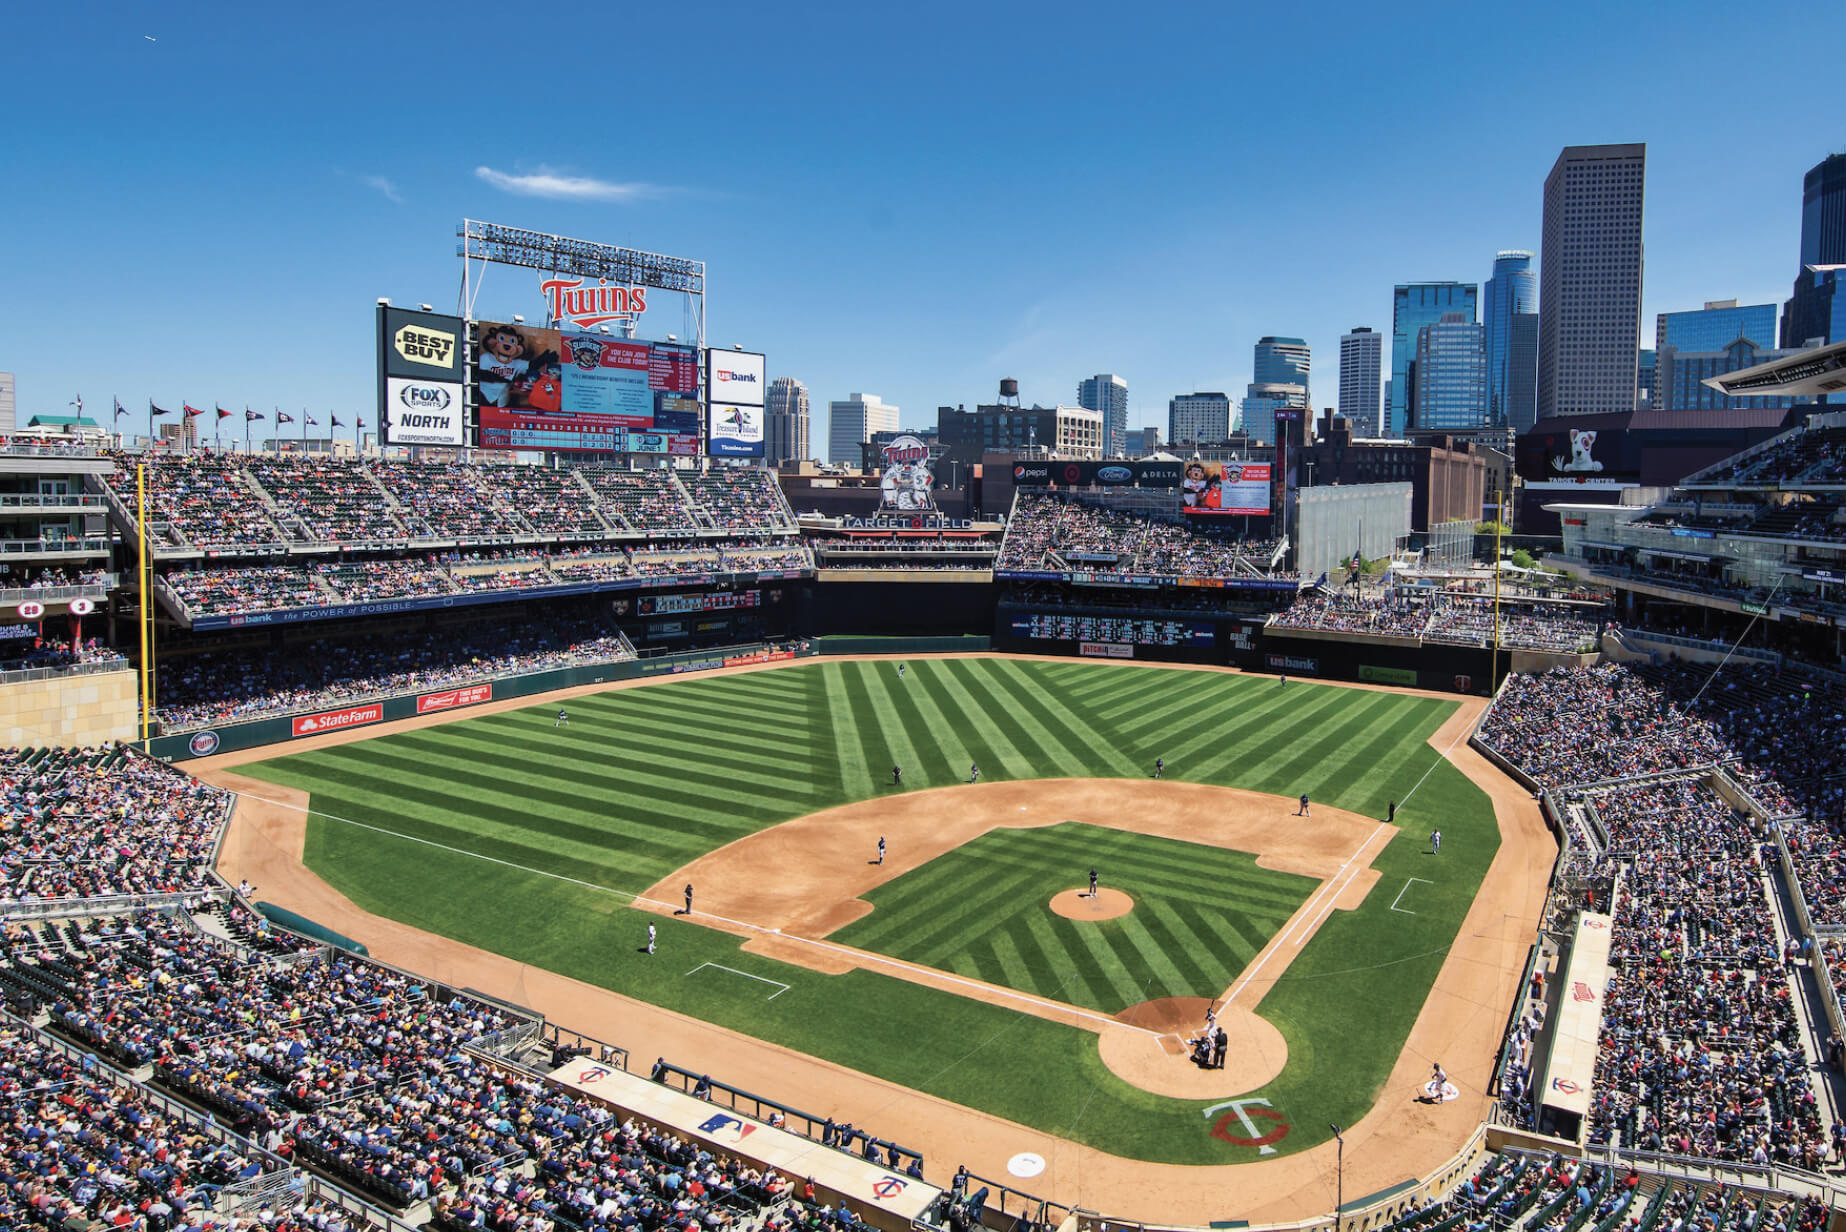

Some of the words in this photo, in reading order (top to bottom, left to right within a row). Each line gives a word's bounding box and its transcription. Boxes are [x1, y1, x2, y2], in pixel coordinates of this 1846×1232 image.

[541, 278, 647, 321] Twins
[403, 331, 453, 351] BEST
[404, 344, 448, 361] BUY
[411, 387, 440, 401] FOX
[401, 414, 450, 429] NORTH
[883, 446, 929, 465] Twins
[1025, 468, 1048, 478] pepsi
[845, 519, 907, 528] TARGET
[925, 519, 973, 529] FIELD
[79, 602, 86, 611] 3
[284, 613, 298, 621] the
[302, 608, 344, 619] POWER
[348, 607, 358, 616] of
